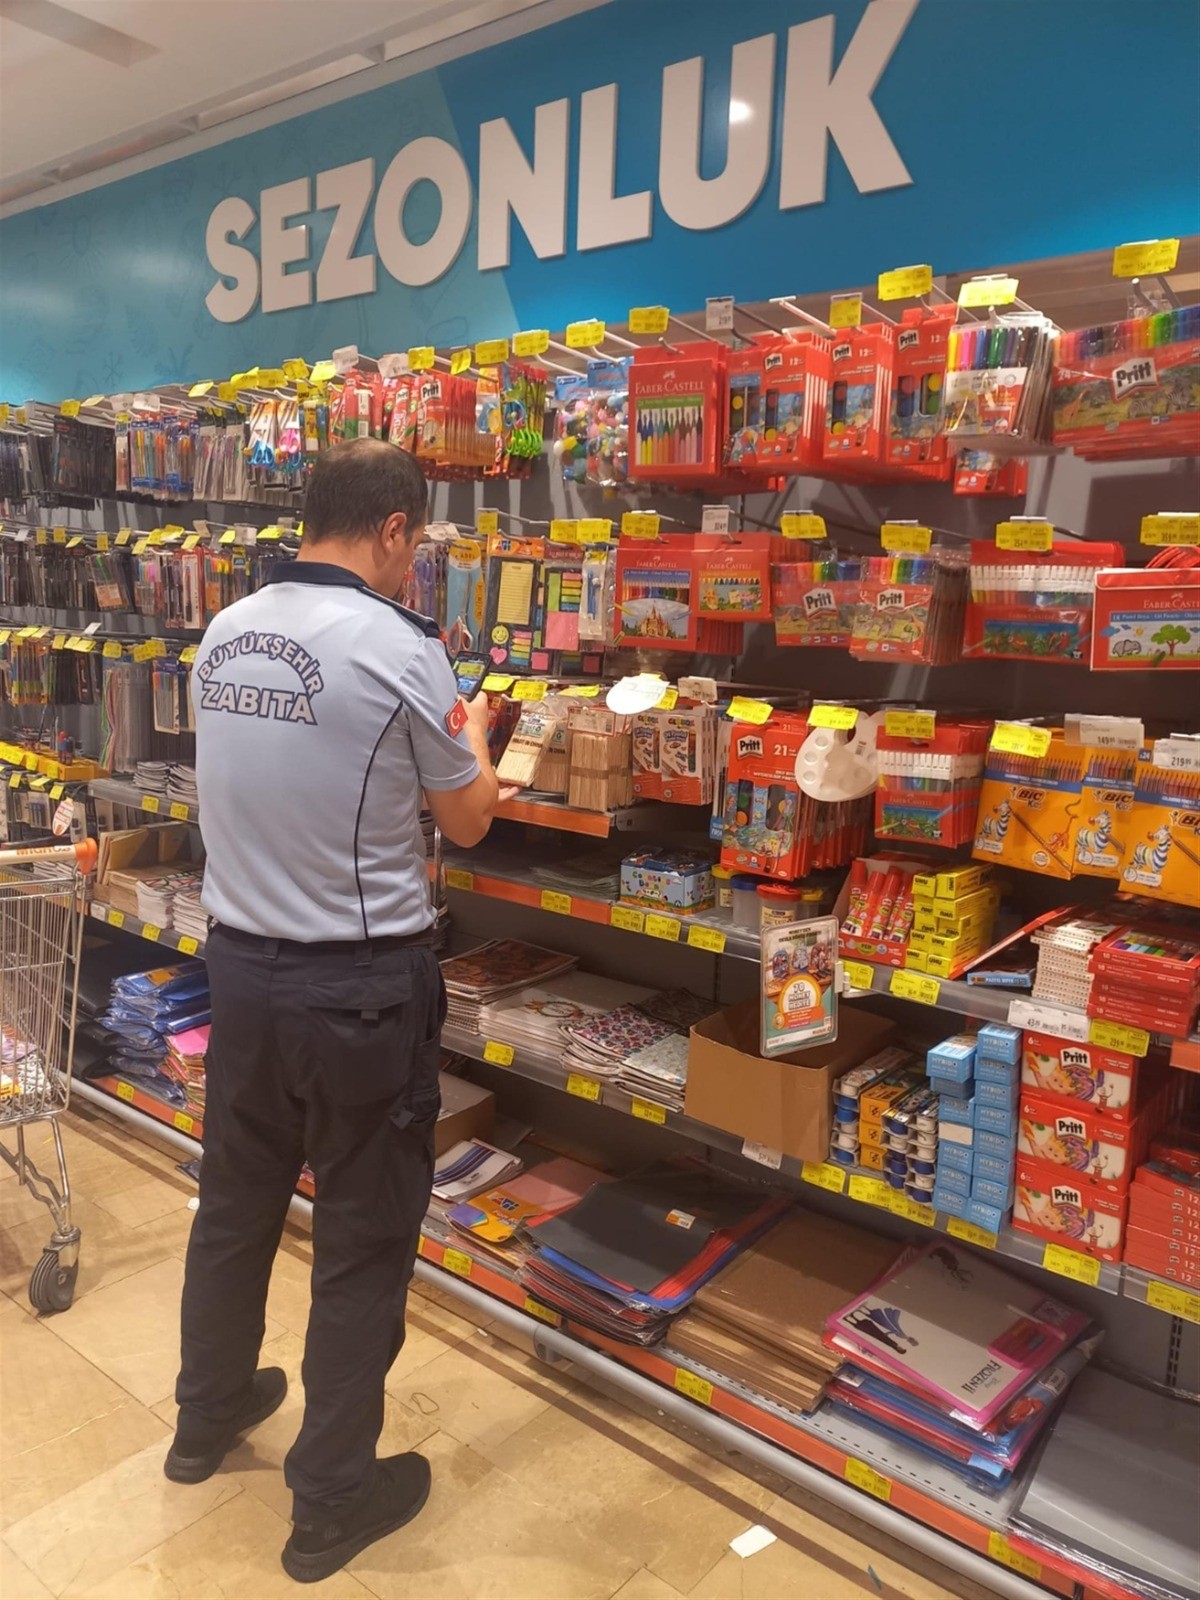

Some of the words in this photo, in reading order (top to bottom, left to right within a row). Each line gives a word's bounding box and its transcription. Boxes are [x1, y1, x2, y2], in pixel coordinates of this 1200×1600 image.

[205, 0, 919, 325] SEZONLUK
[900, 332, 917, 345] Pritt
[834, 346, 850, 358] Pritt
[1115, 362, 1151, 388] Pritt
[422, 385, 439, 398] Pritt
[805, 592, 832, 609] Pritt
[880, 593, 903, 606] Pritt
[198, 631, 324, 697] BÜYÜKŞEHİR
[201, 681, 318, 726] ZABITA
[739, 739, 760, 751] Pritt
[774, 743, 788, 757] 21
[1019, 788, 1042, 801] BIC
[1105, 792, 1130, 803] BIC
[1181, 815, 1200, 826] BI
[914, 877, 928, 885] UHU
[912, 932, 925, 940] UHU
[932, 938, 946, 946] UHU
[929, 957, 943, 965] UHU
[1028, 1037, 1034, 1045] 6
[1063, 1050, 1088, 1064] Pritt
[1023, 1105, 1030, 1113] 6
[1058, 1120, 1083, 1134] Pritt
[1020, 1172, 1026, 1180] 6
[1054, 1188, 1079, 1203] Pritt
[1189, 1194, 1199, 1203] 12
[1187, 1207, 1198, 1217] 12
[1189, 1220, 1199, 1230] 12
[1188, 1232, 1198, 1242] 12
[1185, 1246, 1196, 1256] 12
[1184, 1260, 1196, 1270] 12
[1181, 1272, 1192, 1282] 12
